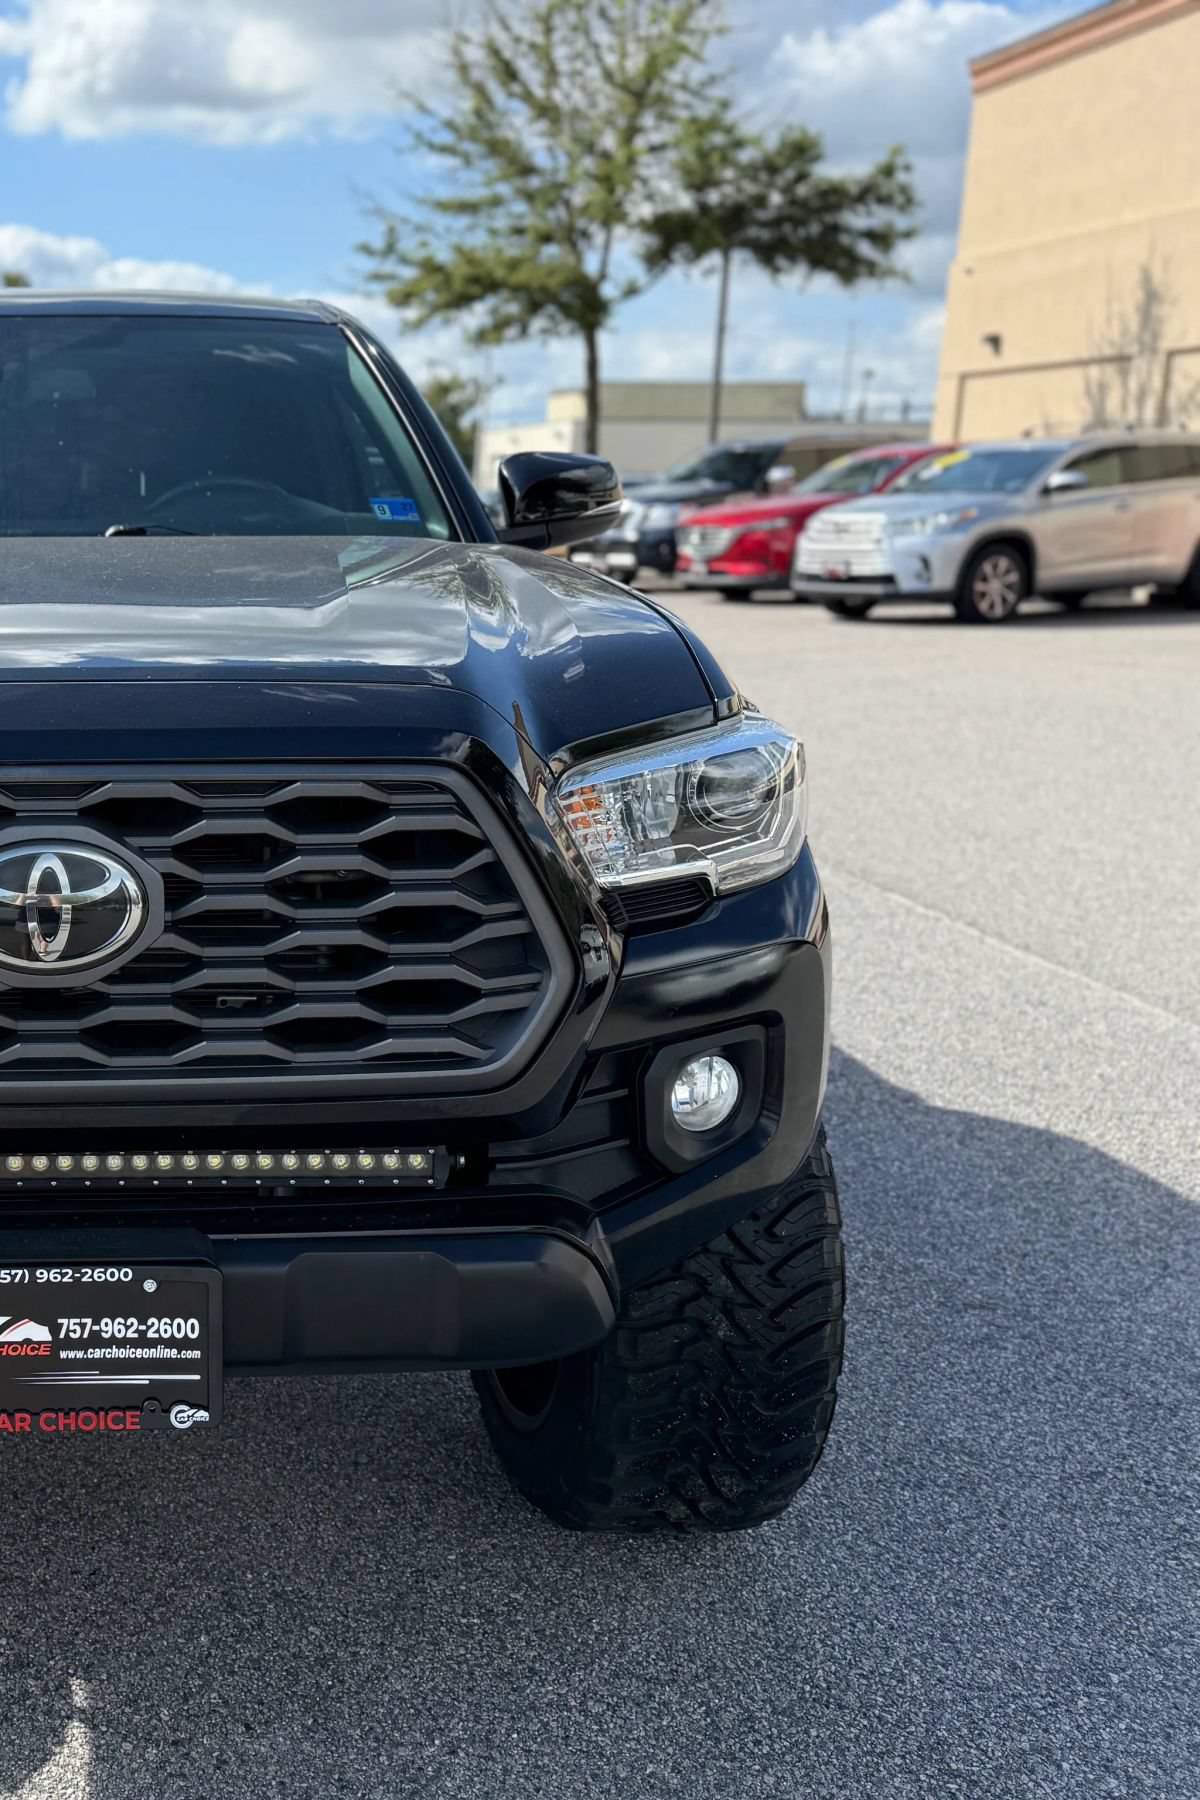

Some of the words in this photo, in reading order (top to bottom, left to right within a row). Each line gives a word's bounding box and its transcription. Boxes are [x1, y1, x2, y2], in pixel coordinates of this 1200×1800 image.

[35, 1267, 133, 1282] 962-2600
[57, 1317, 200, 1339] 757-962-2600
[59, 1345, 201, 1359] www.carchoiceonline.com
[39, 1411, 141, 1432] CHOICE
